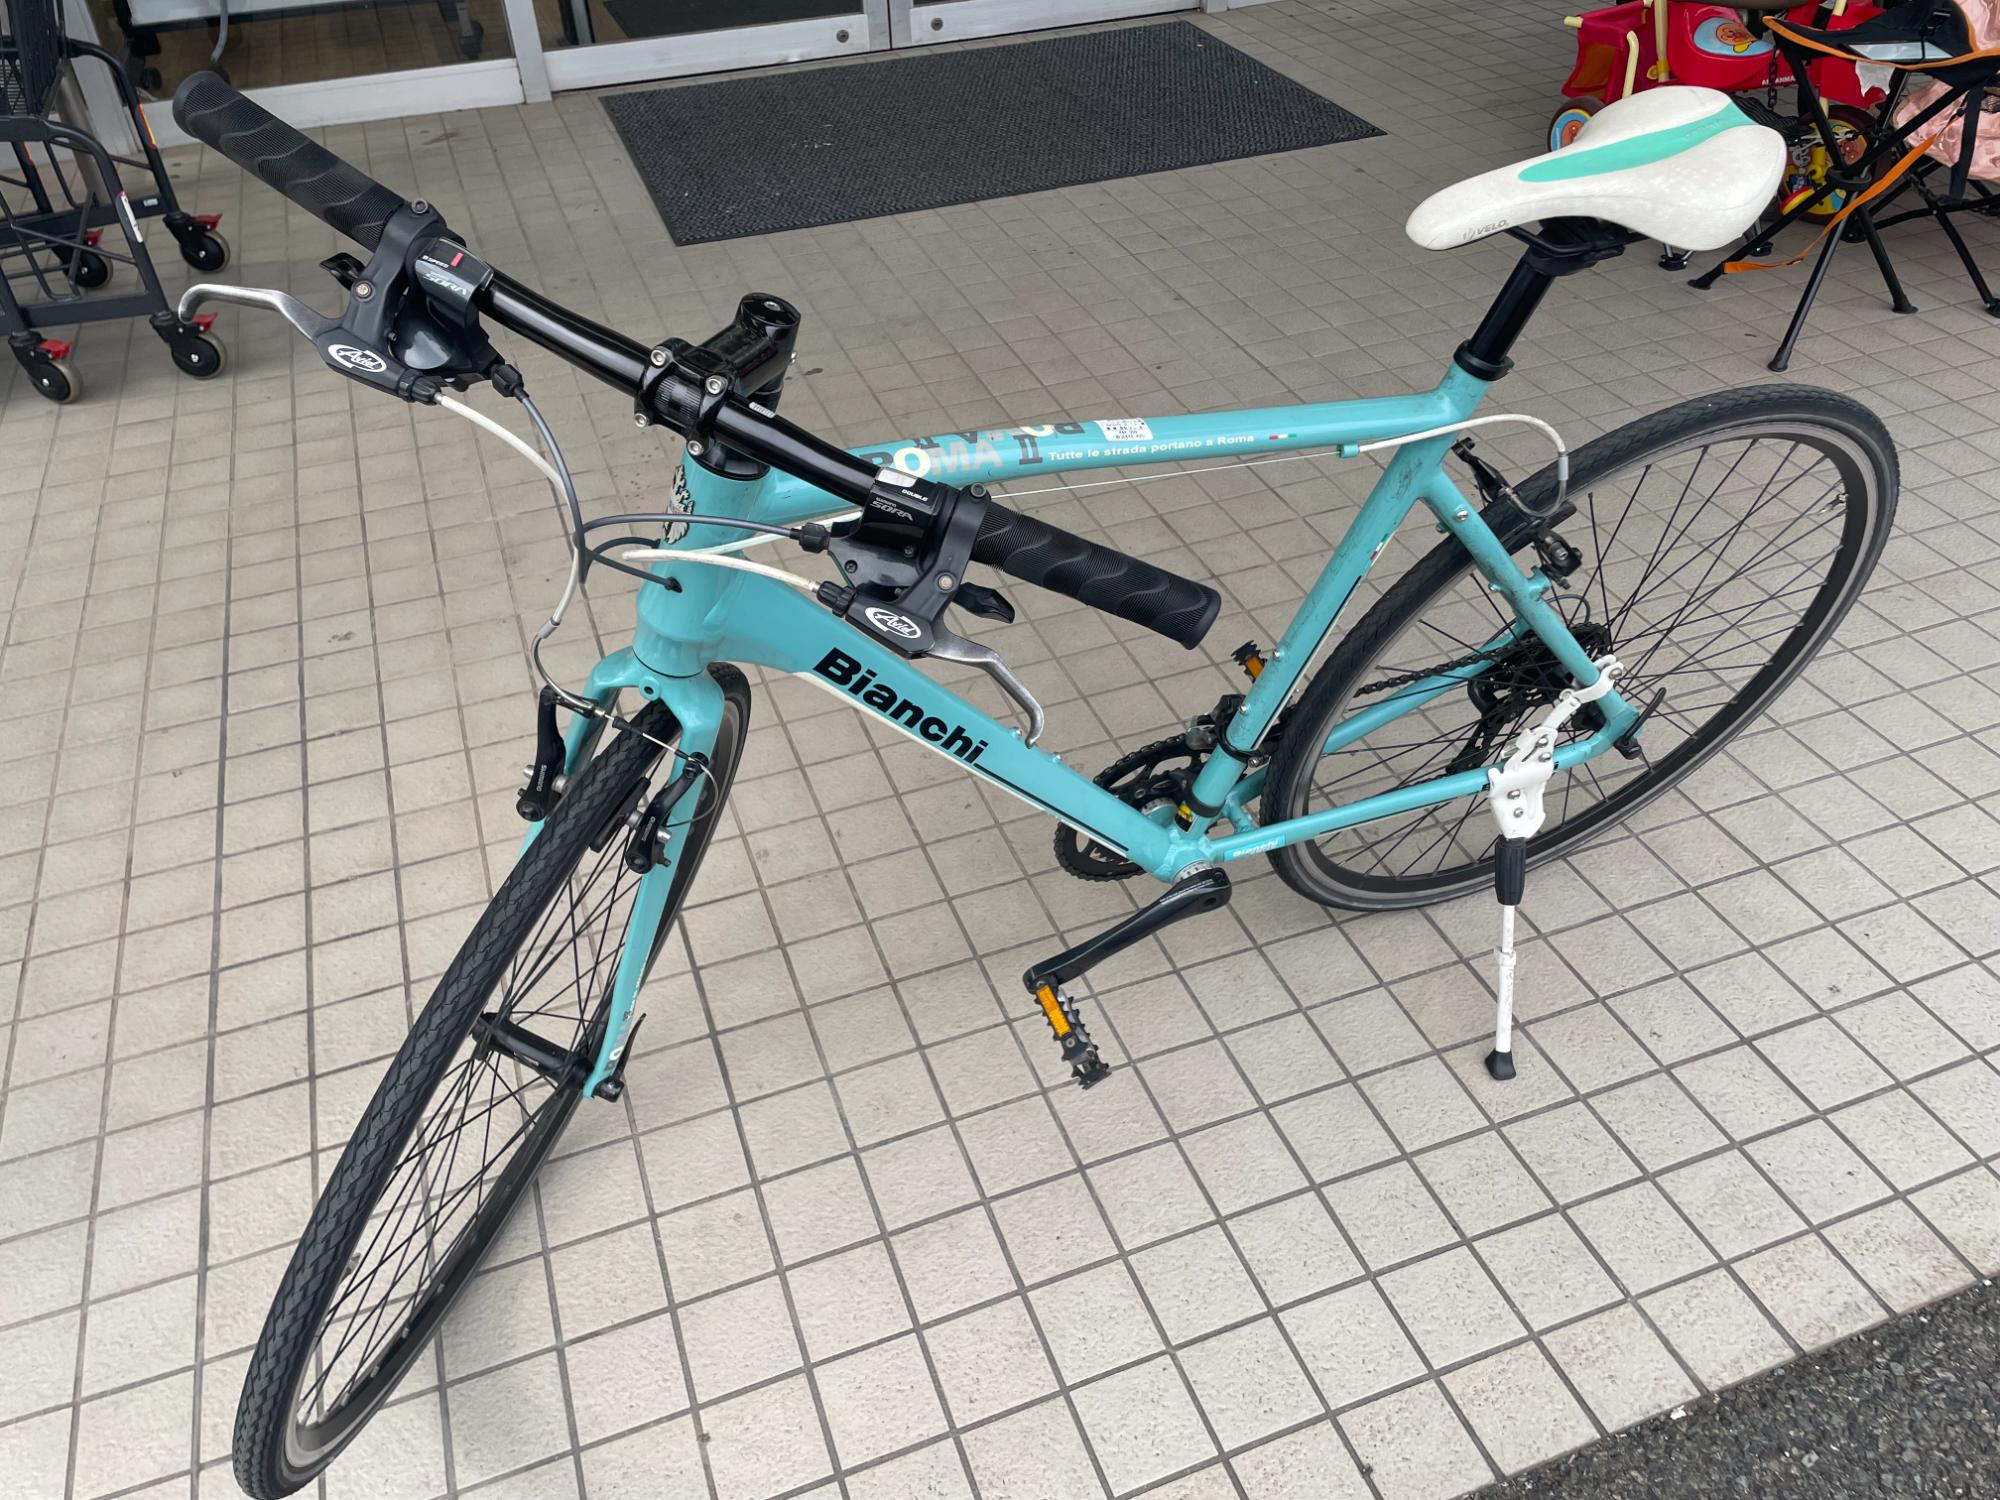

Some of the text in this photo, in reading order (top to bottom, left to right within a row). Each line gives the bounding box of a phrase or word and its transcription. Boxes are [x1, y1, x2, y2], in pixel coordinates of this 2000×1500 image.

[1047, 451, 1083, 461] Tutte
[1087, 449, 1099, 457] le
[1104, 446, 1146, 457] strada
[1151, 439, 1202, 453] portano
[1217, 434, 1254, 445] Roma
[870, 500, 913, 521] SORA
[813, 647, 989, 764] Bianchi
